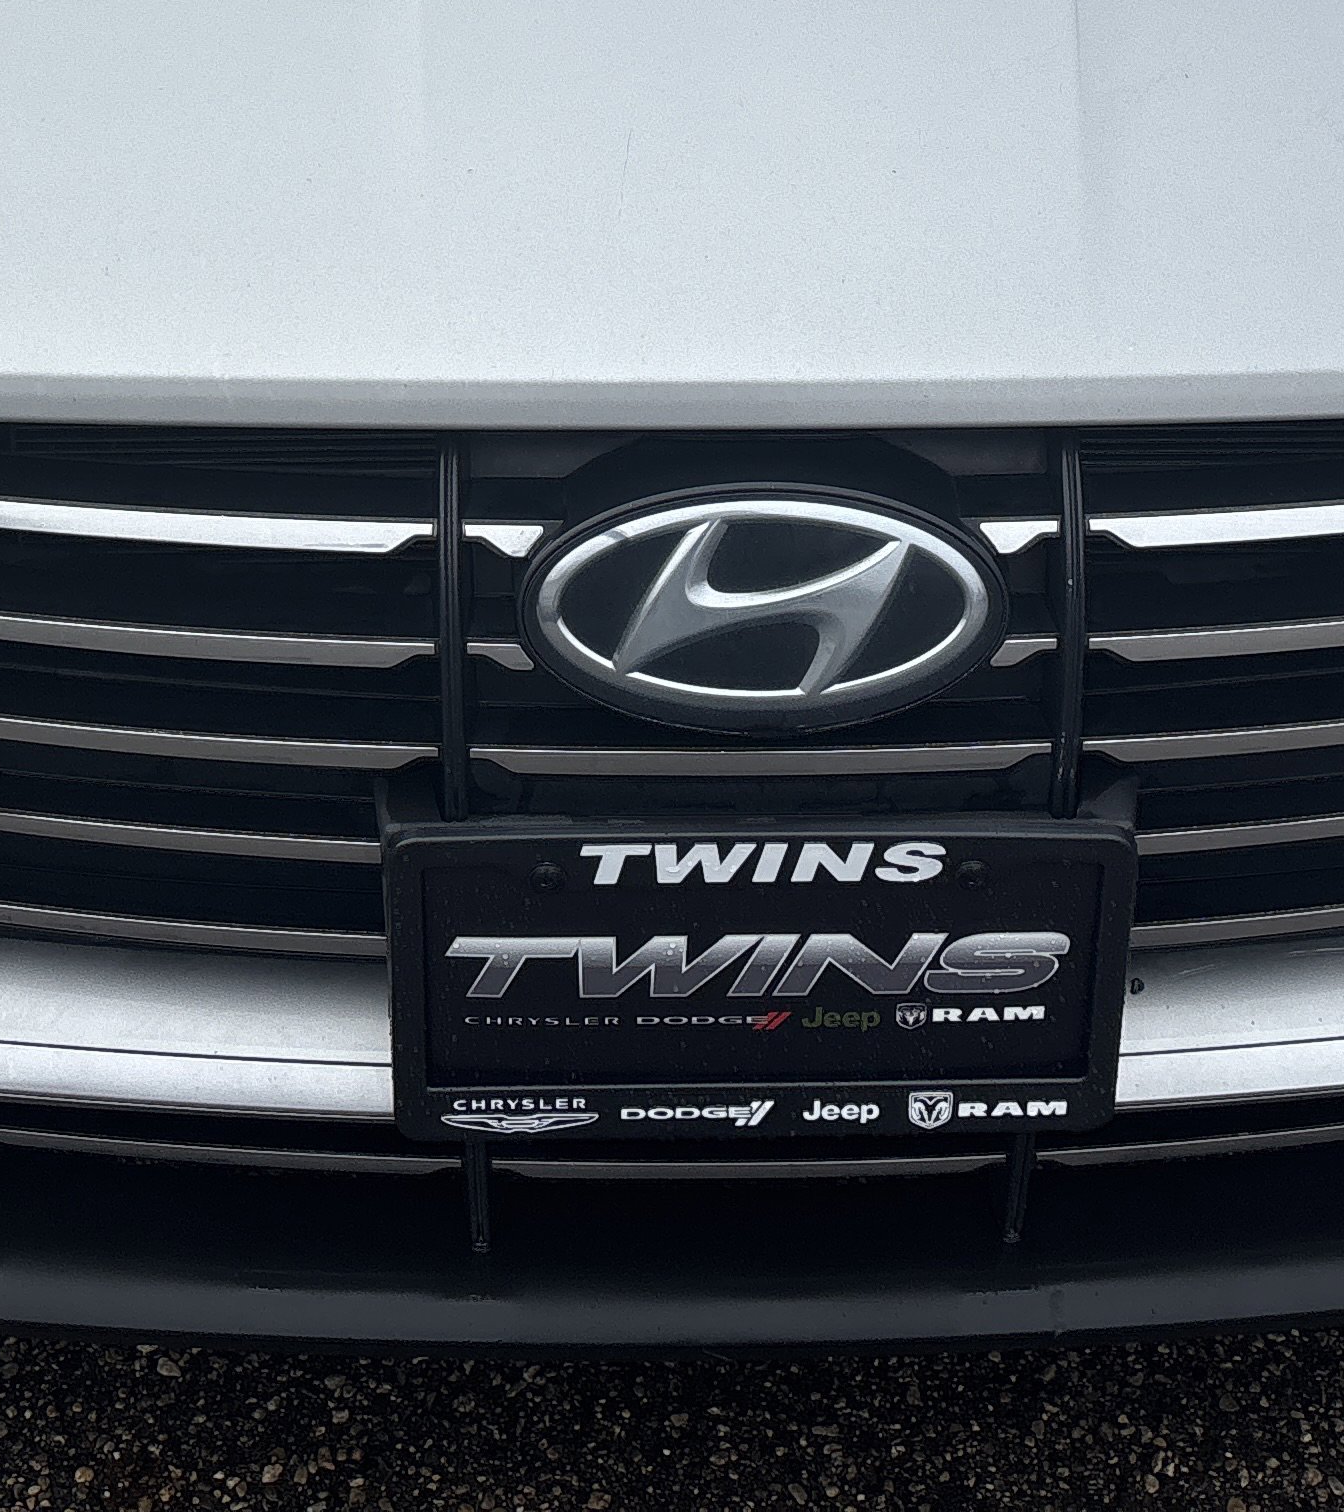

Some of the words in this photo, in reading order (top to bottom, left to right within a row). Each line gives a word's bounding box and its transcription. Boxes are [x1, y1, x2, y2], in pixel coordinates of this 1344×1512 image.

[580, 842, 947, 884] TWINS
[445, 933, 1071, 997] TWINS
[464, 1016, 620, 1026] CHRYSLER
[636, 1015, 770, 1026] DODGE
[802, 1006, 881, 1031] Jeep
[932, 1005, 1046, 1023] RAM
[452, 1098, 586, 1111] CHRYSLER
[620, 1106, 754, 1120] DODGE
[802, 1100, 880, 1124] Jeep
[958, 1101, 1068, 1117] RAM
